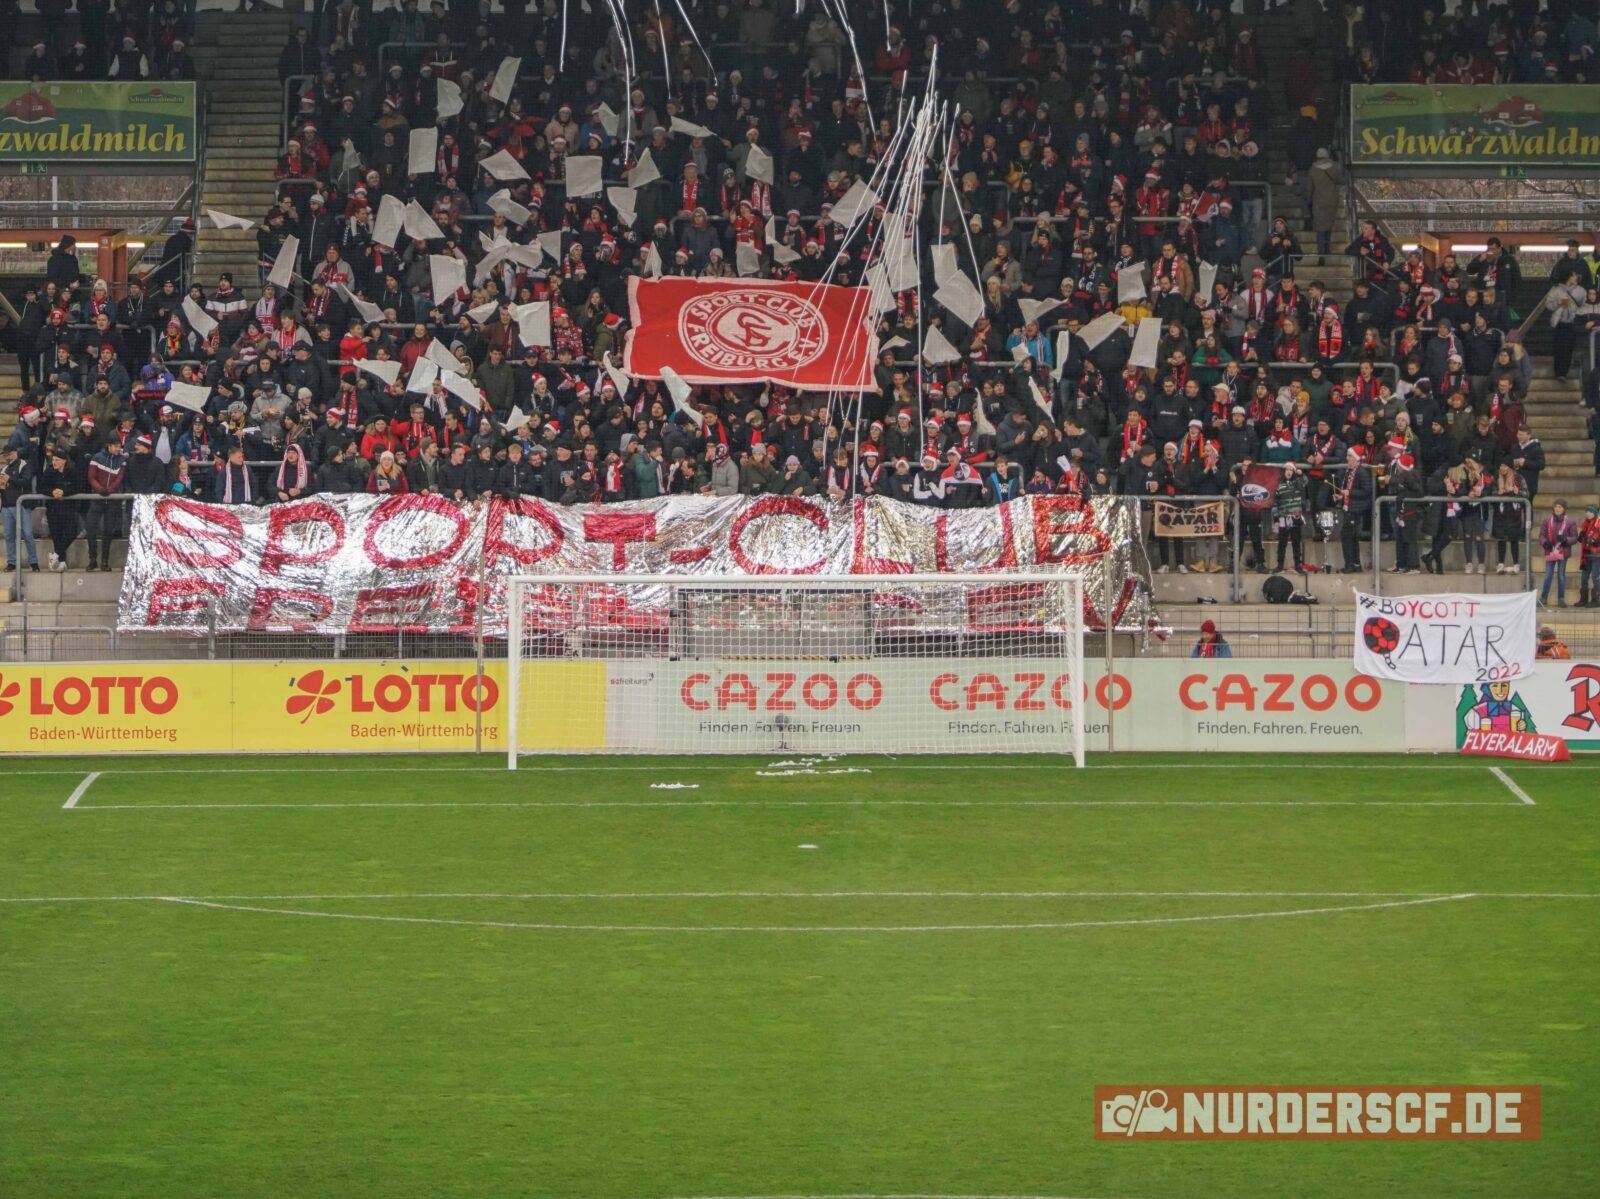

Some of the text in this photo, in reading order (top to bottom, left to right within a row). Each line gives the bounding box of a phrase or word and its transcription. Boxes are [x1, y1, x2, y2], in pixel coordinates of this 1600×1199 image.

[691, 293, 817, 329] SPORT-CLUB
[688, 322, 788, 369] FREIBURG
[1193, 525, 1220, 534] 2022
[1475, 662, 1521, 682] 2022
[30, 676, 179, 715] LOTTO
[351, 674, 499, 713] LOTTO
[680, 673, 883, 711] CAZOO
[929, 673, 1132, 711] CAZOO
[1179, 673, 1382, 711] CAZOO
[30, 726, 177, 742] Baden-Württemberg
[1197, 721, 1363, 735] Finden. Fahren. Freuen.
[1461, 732, 1560, 757] FLYERALARM
